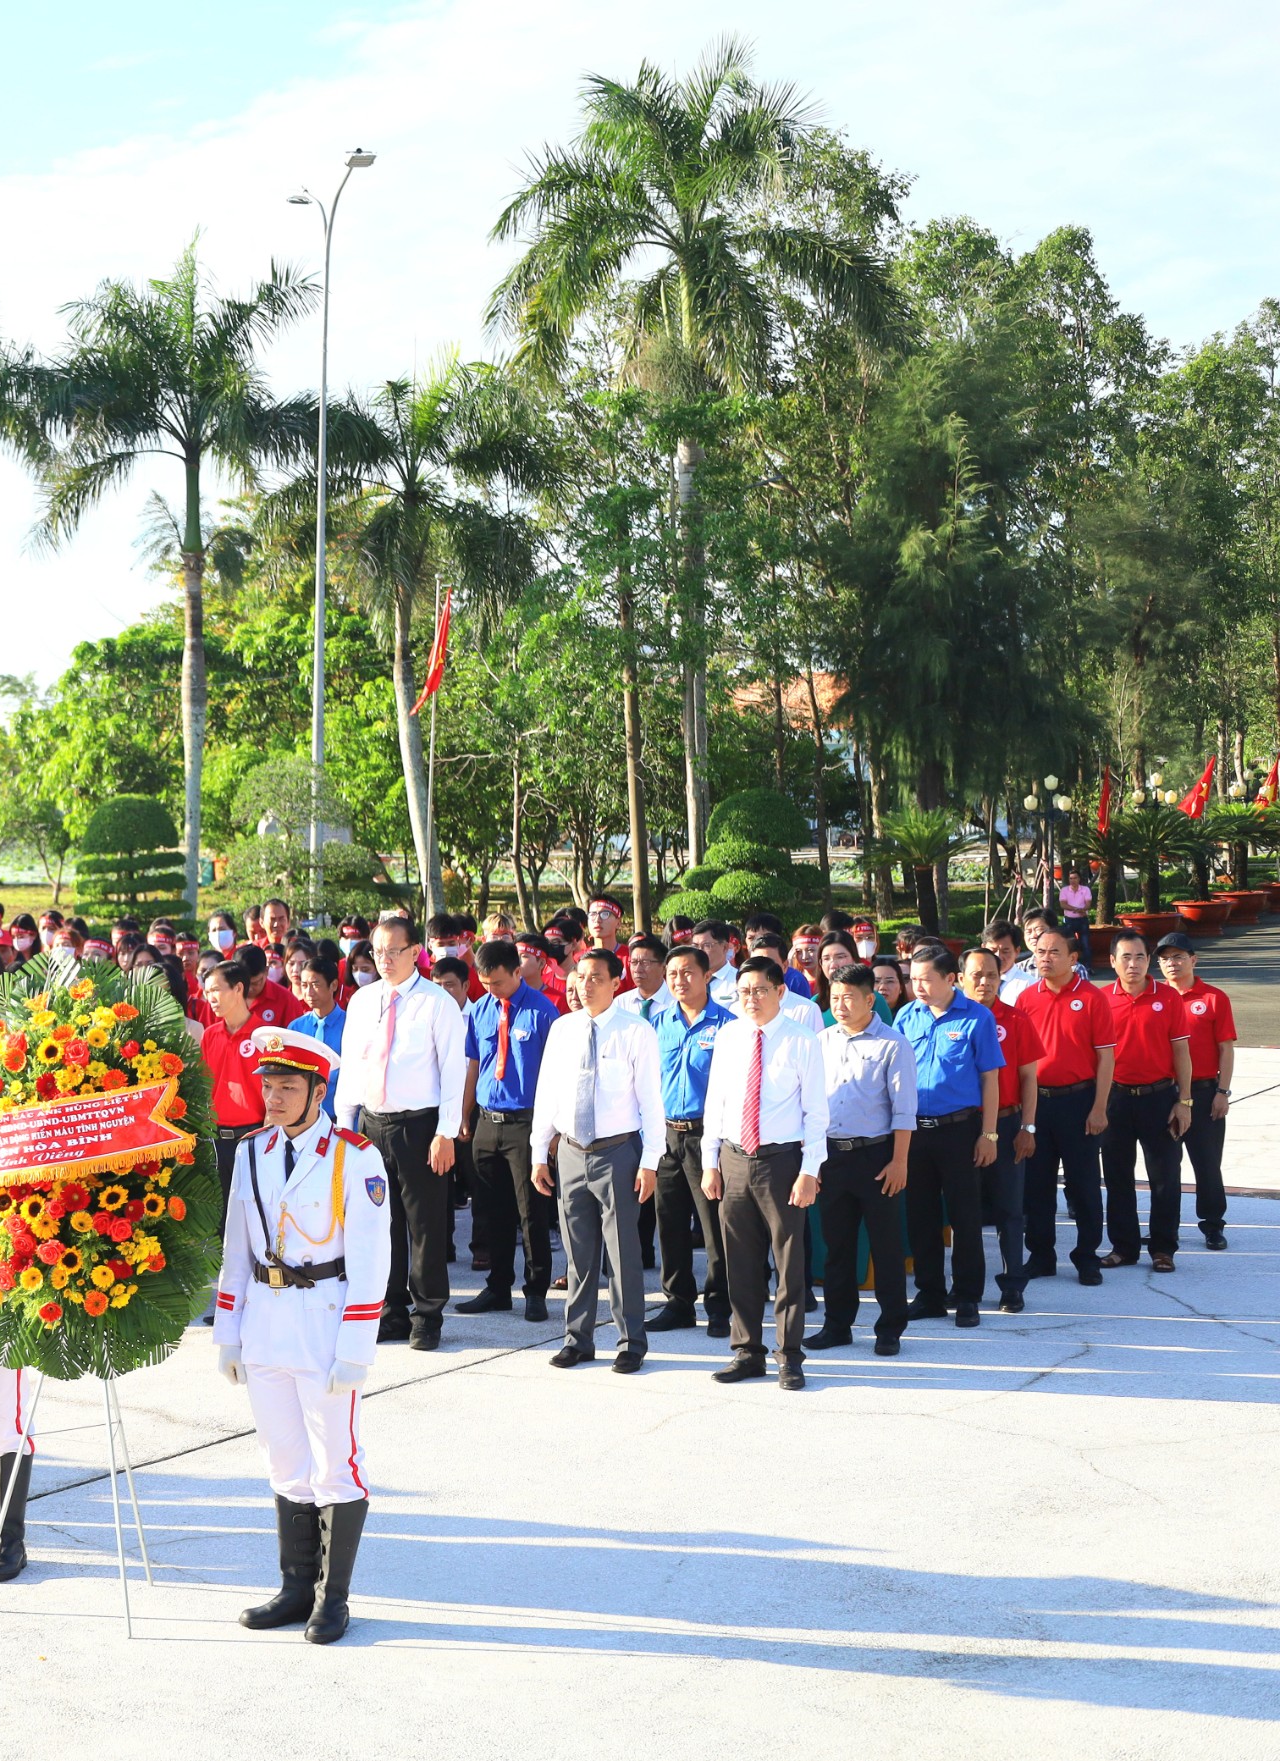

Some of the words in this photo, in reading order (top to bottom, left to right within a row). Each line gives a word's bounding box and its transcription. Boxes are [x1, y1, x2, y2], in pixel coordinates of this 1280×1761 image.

[37, 1106, 62, 1118] ANH
[65, 1101, 100, 1113] HÙNG
[31, 1127, 52, 1140] HIẾN
[54, 1126, 74, 1137] MÁU
[76, 1123, 98, 1134] TÌNH
[100, 1115, 135, 1129] NGUYỆN
[23, 1141, 62, 1153] HÒA
[67, 1132, 112, 1147] BÌNH
[32, 1150, 84, 1161] Viếng
